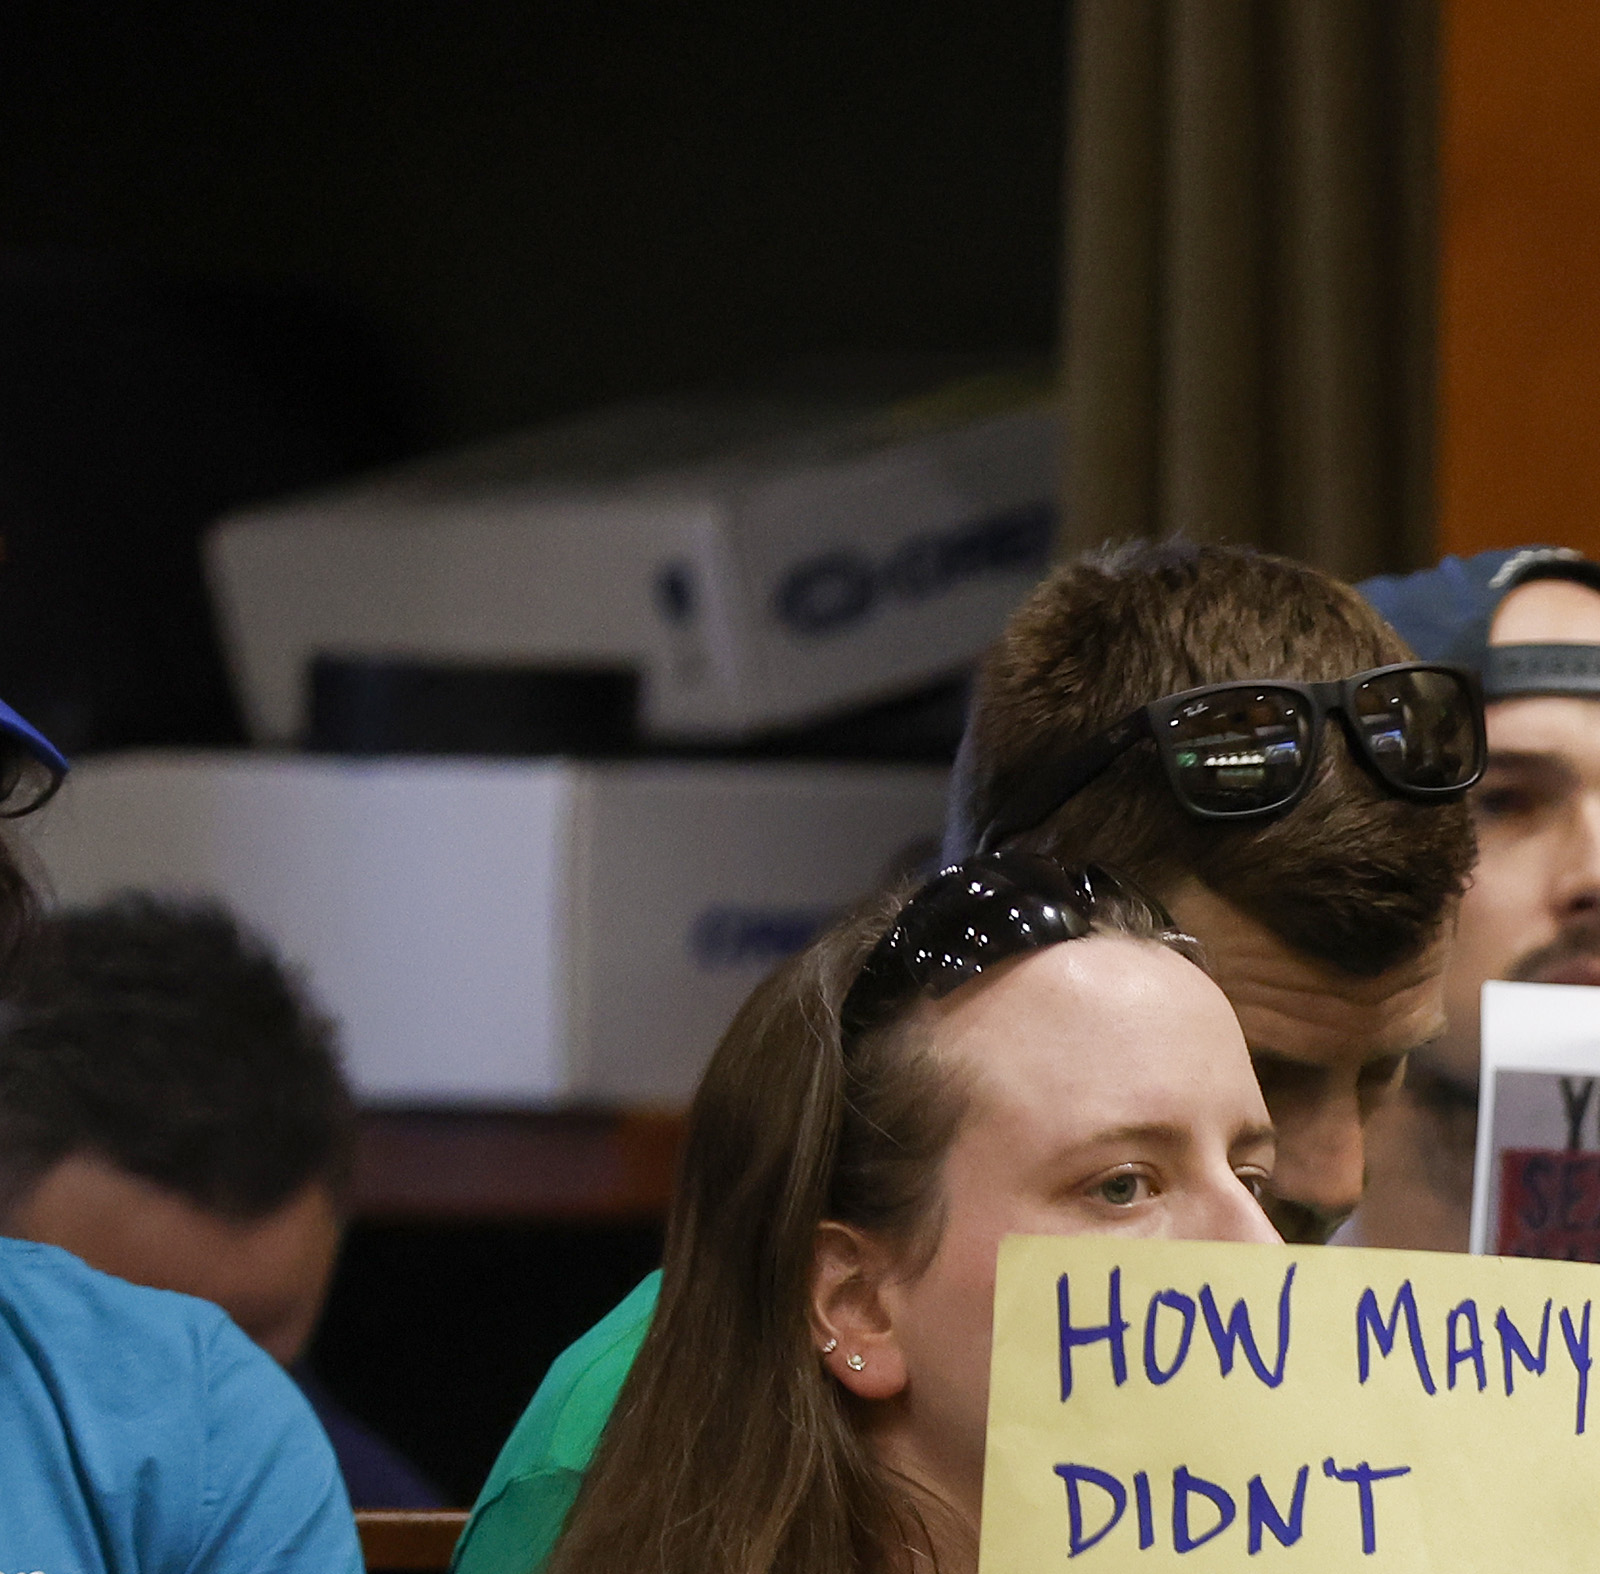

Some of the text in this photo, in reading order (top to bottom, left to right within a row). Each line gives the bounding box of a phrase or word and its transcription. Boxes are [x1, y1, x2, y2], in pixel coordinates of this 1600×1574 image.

[1055, 1262, 1594, 1436] HOW MANY
[1053, 1455, 1412, 1558] DIDN'T
